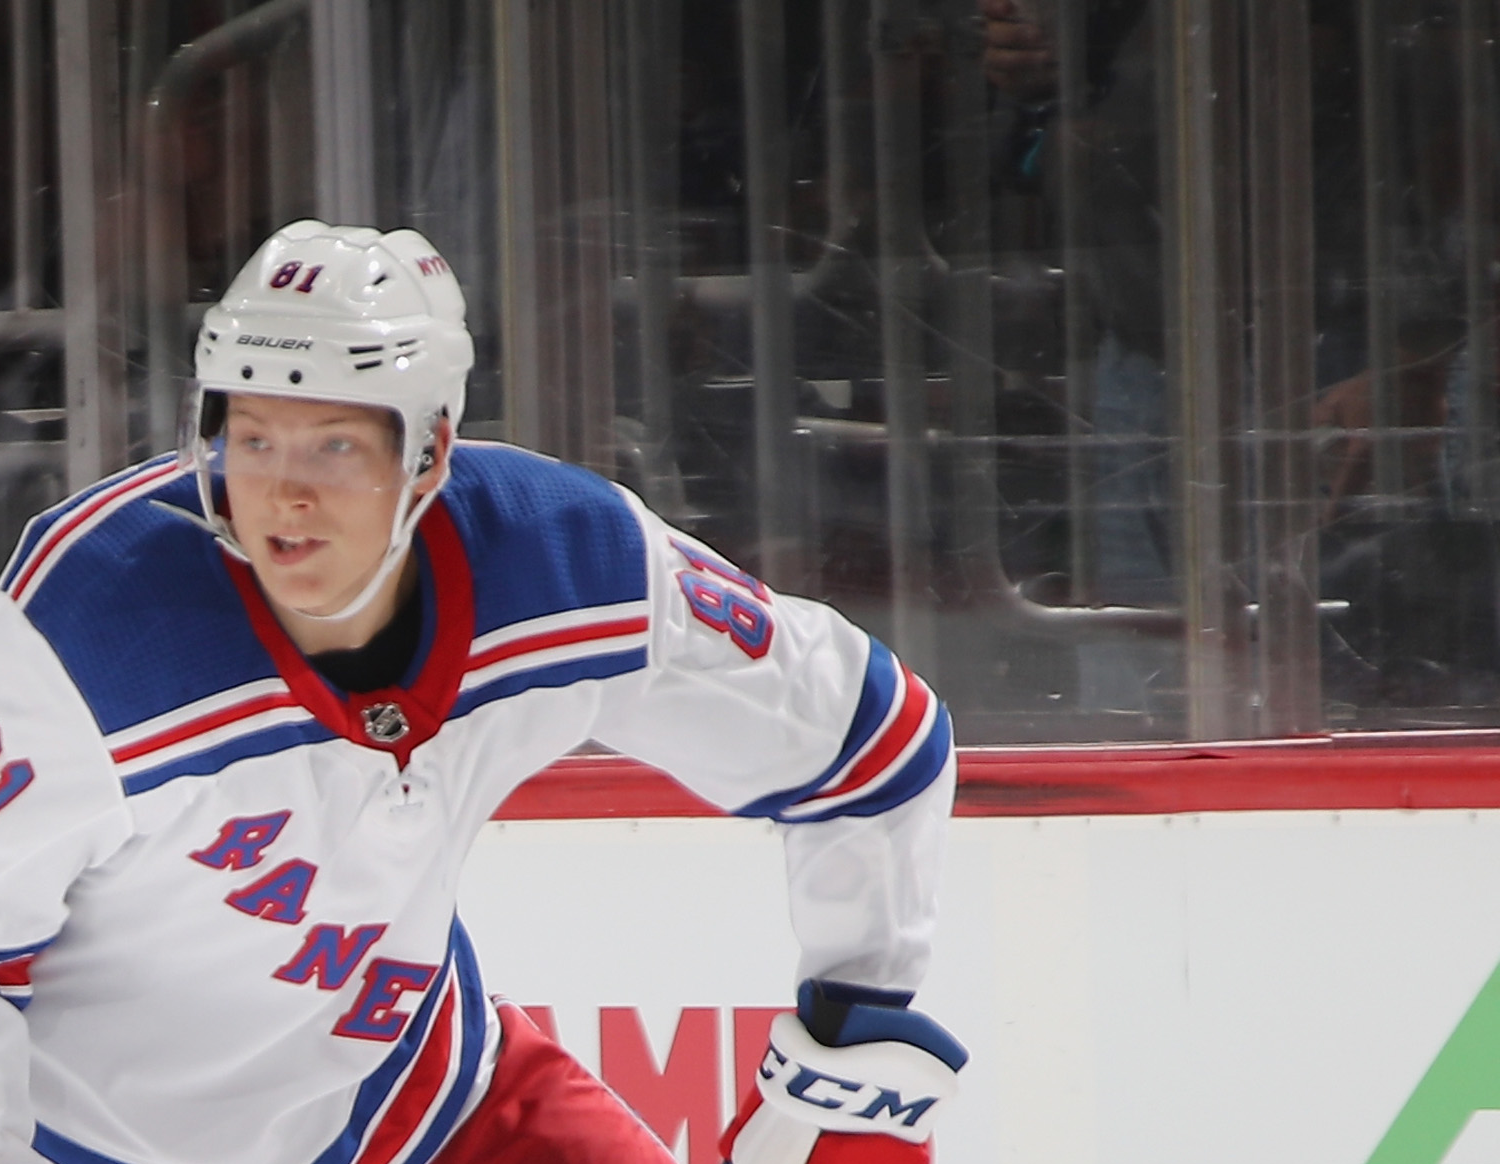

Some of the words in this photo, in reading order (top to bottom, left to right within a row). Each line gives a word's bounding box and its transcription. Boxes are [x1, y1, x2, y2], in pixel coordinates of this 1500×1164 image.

[269, 260, 325, 294] 81
[236, 334, 314, 351] BAUER
[667, 534, 775, 661] 81
[189, 809, 440, 1043] RANE
[758, 1045, 941, 1128] CCM
